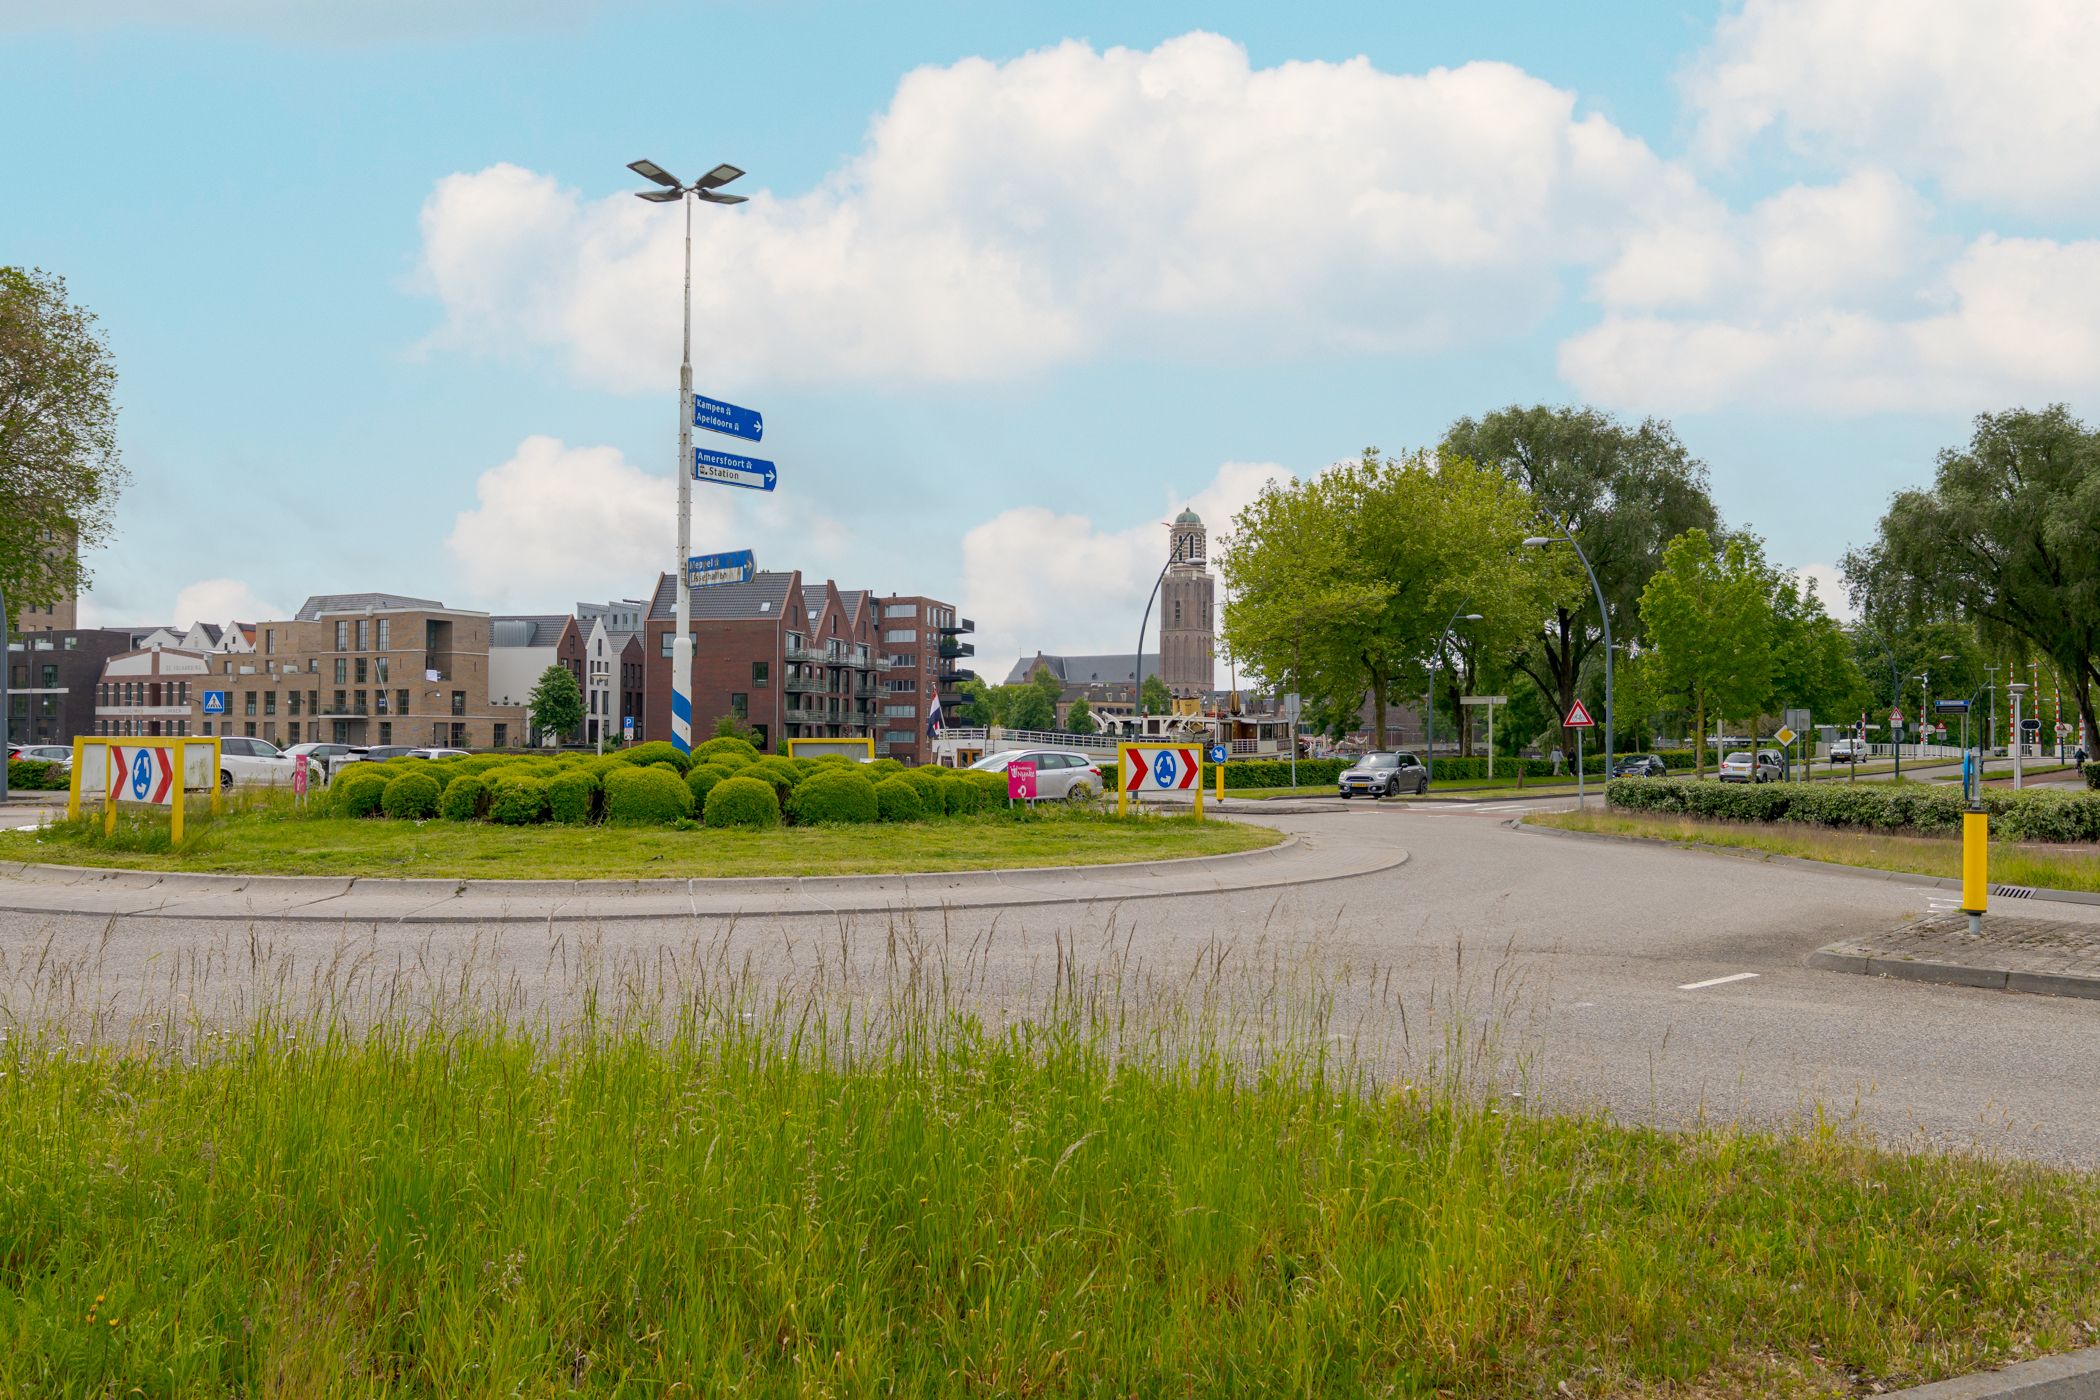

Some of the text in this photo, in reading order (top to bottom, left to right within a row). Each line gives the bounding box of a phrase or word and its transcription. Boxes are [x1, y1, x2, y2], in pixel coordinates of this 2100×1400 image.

[697, 399, 725, 414] Kampen
[697, 413, 733, 429] Apeldoorn
[698, 452, 746, 467] Amersfoort
[709, 467, 739, 480] Station
